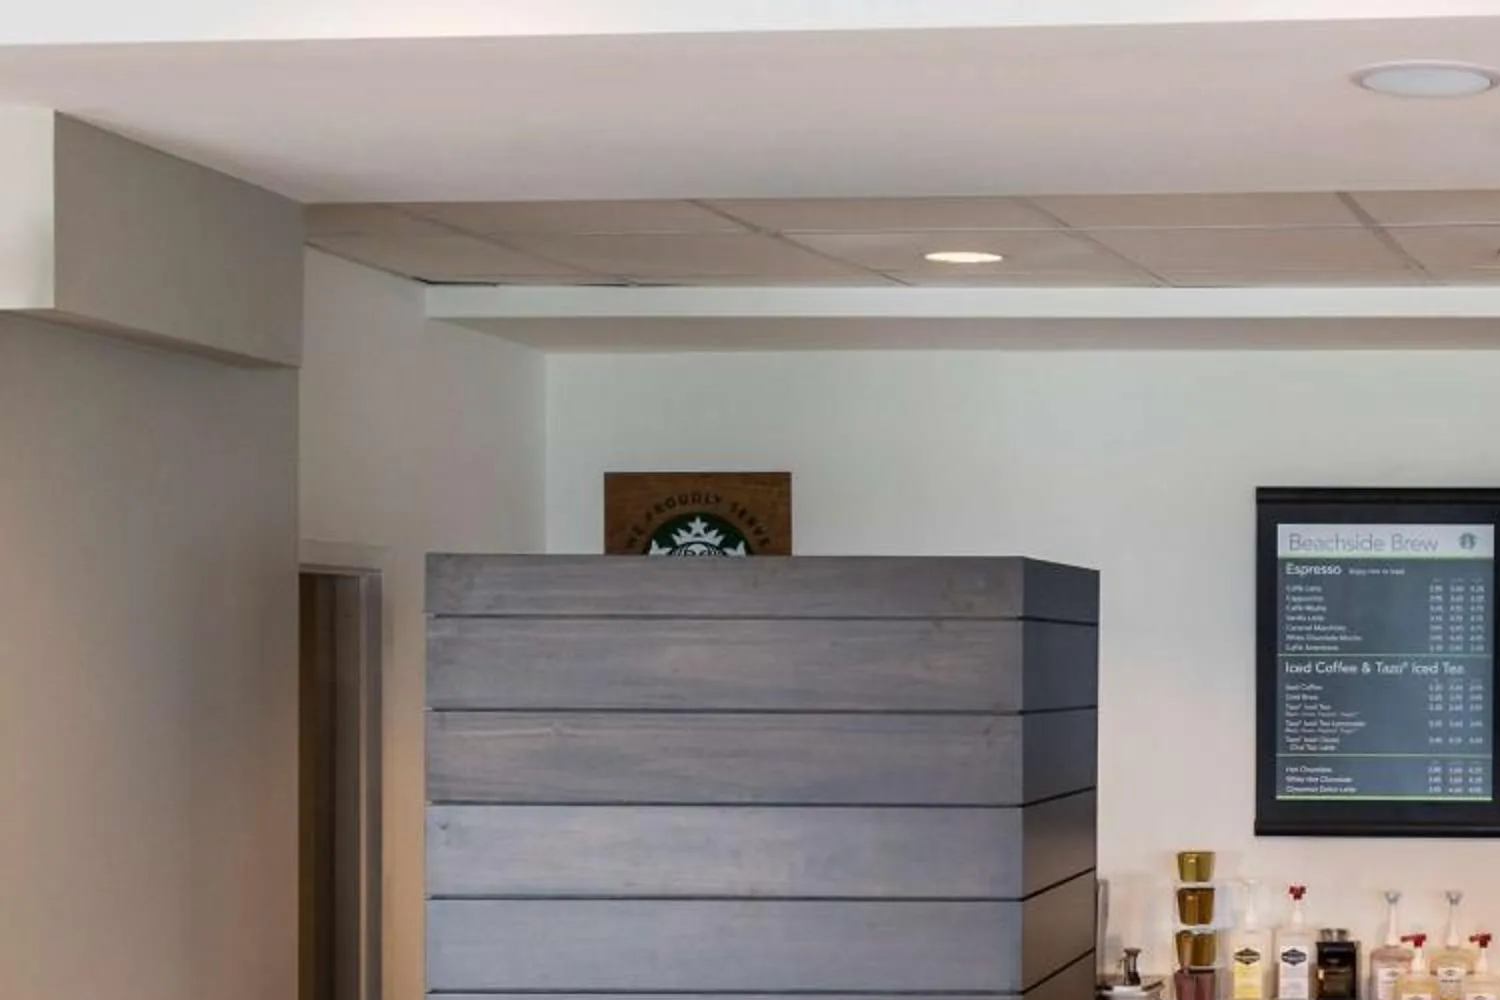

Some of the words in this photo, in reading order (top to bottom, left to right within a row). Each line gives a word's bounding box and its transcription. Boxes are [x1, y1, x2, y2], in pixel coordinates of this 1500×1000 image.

[1289, 532, 1385, 551] Beachside
[1391, 533, 1439, 551] Brew
[1286, 563, 1342, 577] Espresso
[1286, 661, 1312, 674] Iced
[1315, 661, 1358, 674] Coffee
[1361, 662, 1371, 674] &
[1411, 661, 1439, 674] Iced
[1442, 662, 1465, 674] Tea
